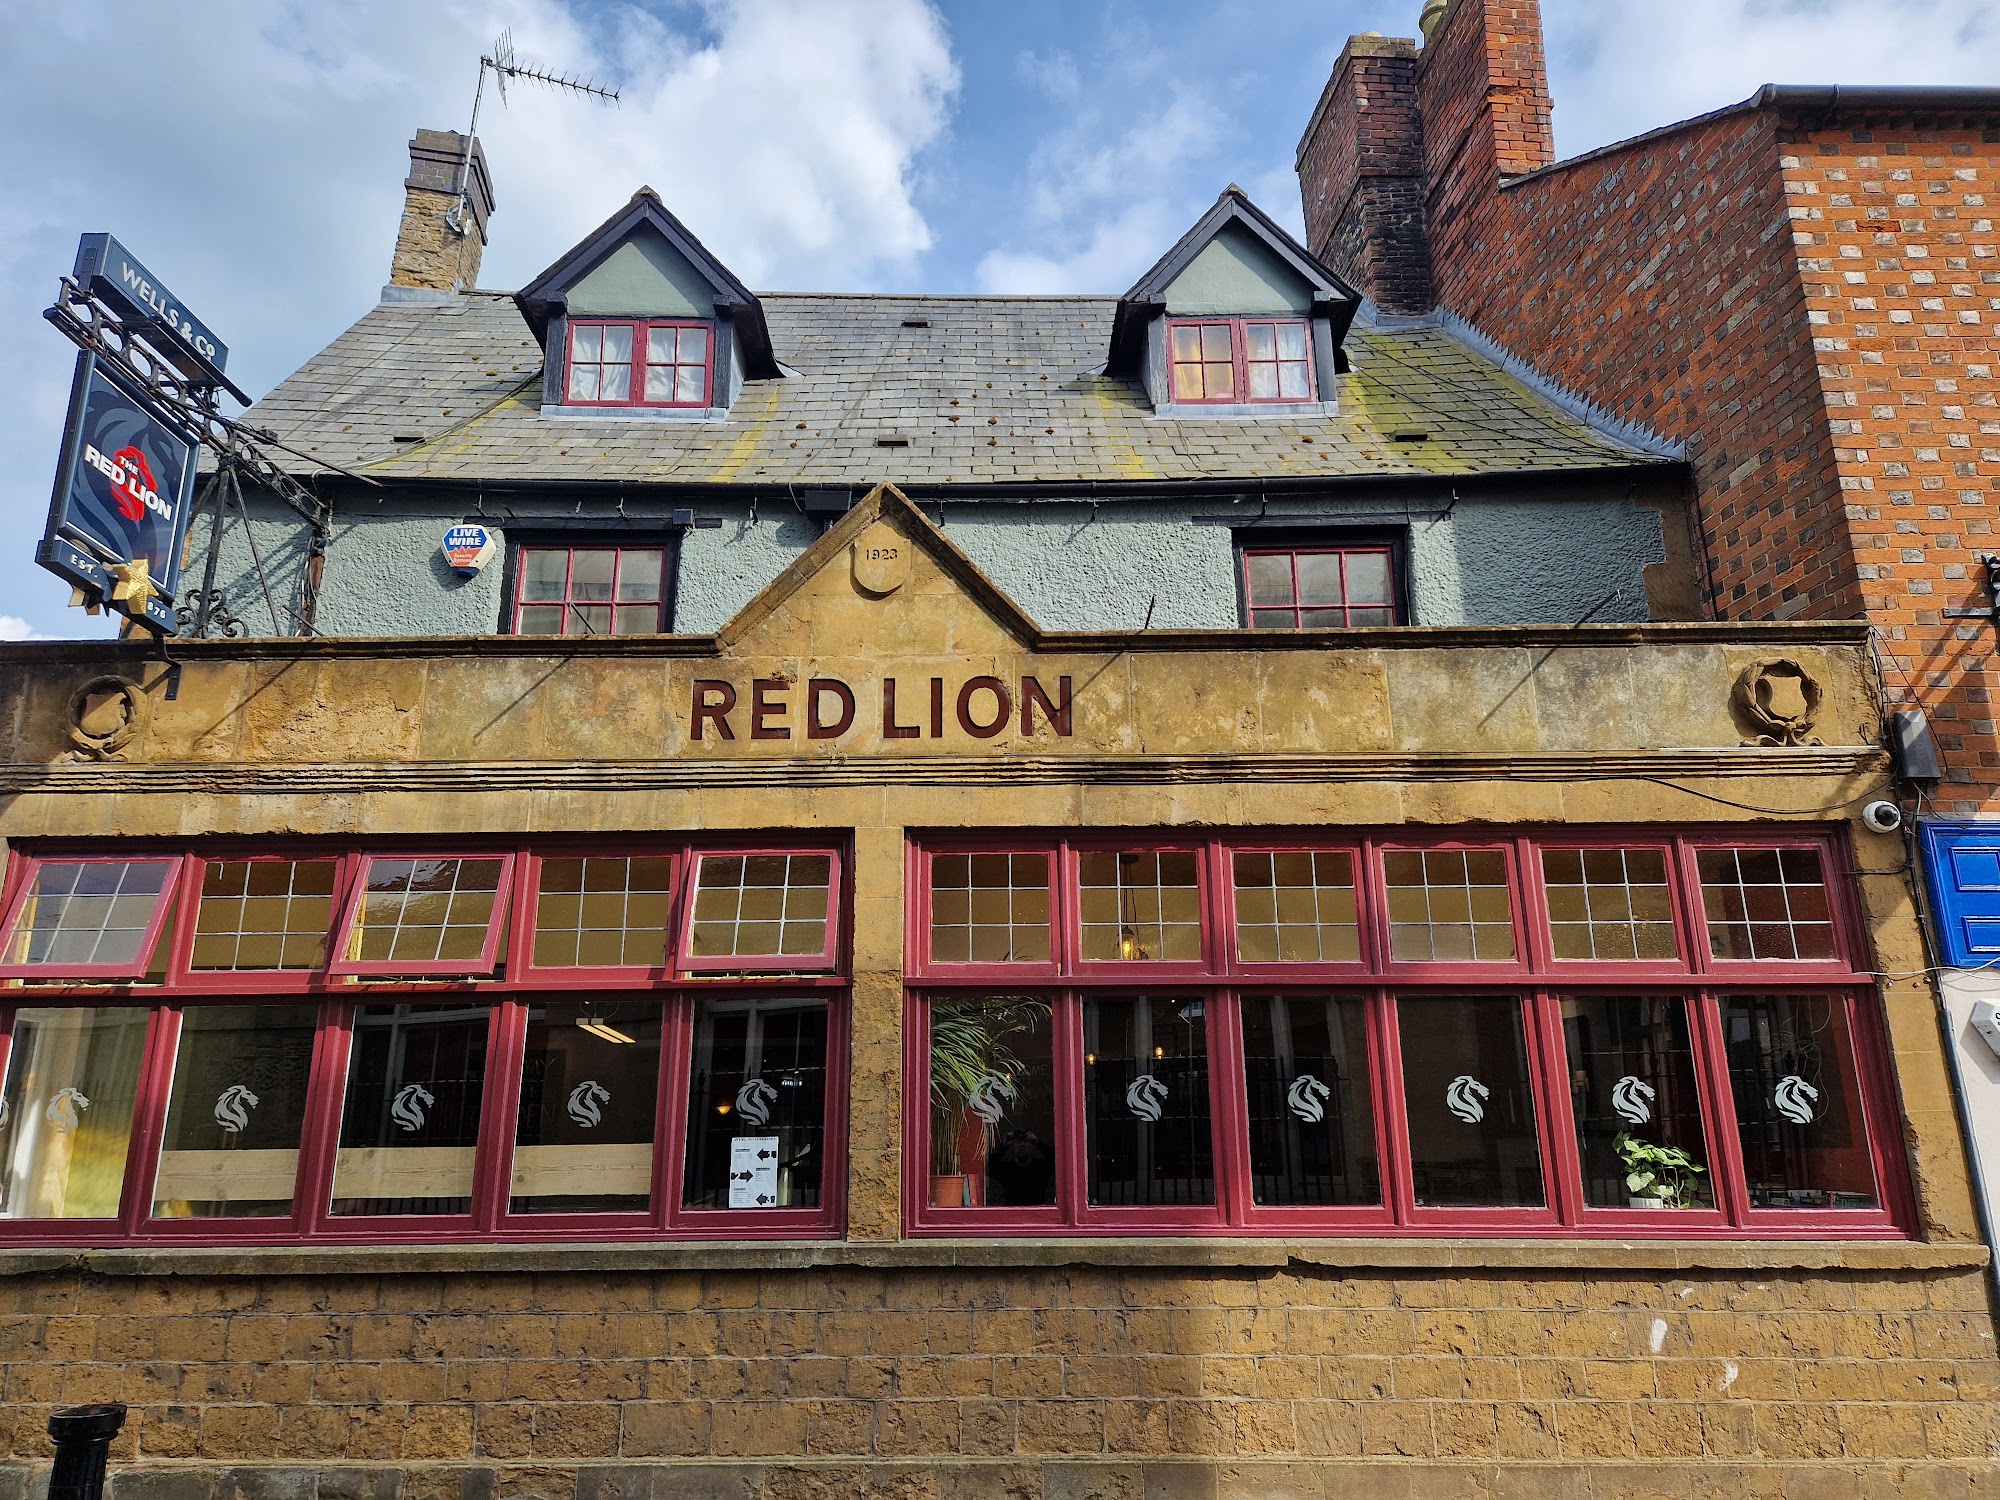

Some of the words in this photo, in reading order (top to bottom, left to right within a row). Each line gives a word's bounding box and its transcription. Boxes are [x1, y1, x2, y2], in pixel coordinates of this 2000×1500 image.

[121, 261, 180, 328] WELLS
[181, 322, 194, 342] &
[84, 443, 126, 486] RED
[128, 478, 173, 521] LION
[119, 456, 139, 475] THE
[449, 538, 481, 546] WIRE
[453, 529, 479, 537] LIVE
[866, 548, 898, 560] 1923
[70, 554, 98, 578] EST.
[147, 601, 166, 619] 876
[690, 678, 856, 740] RED
[883, 675, 1072, 739] LION
